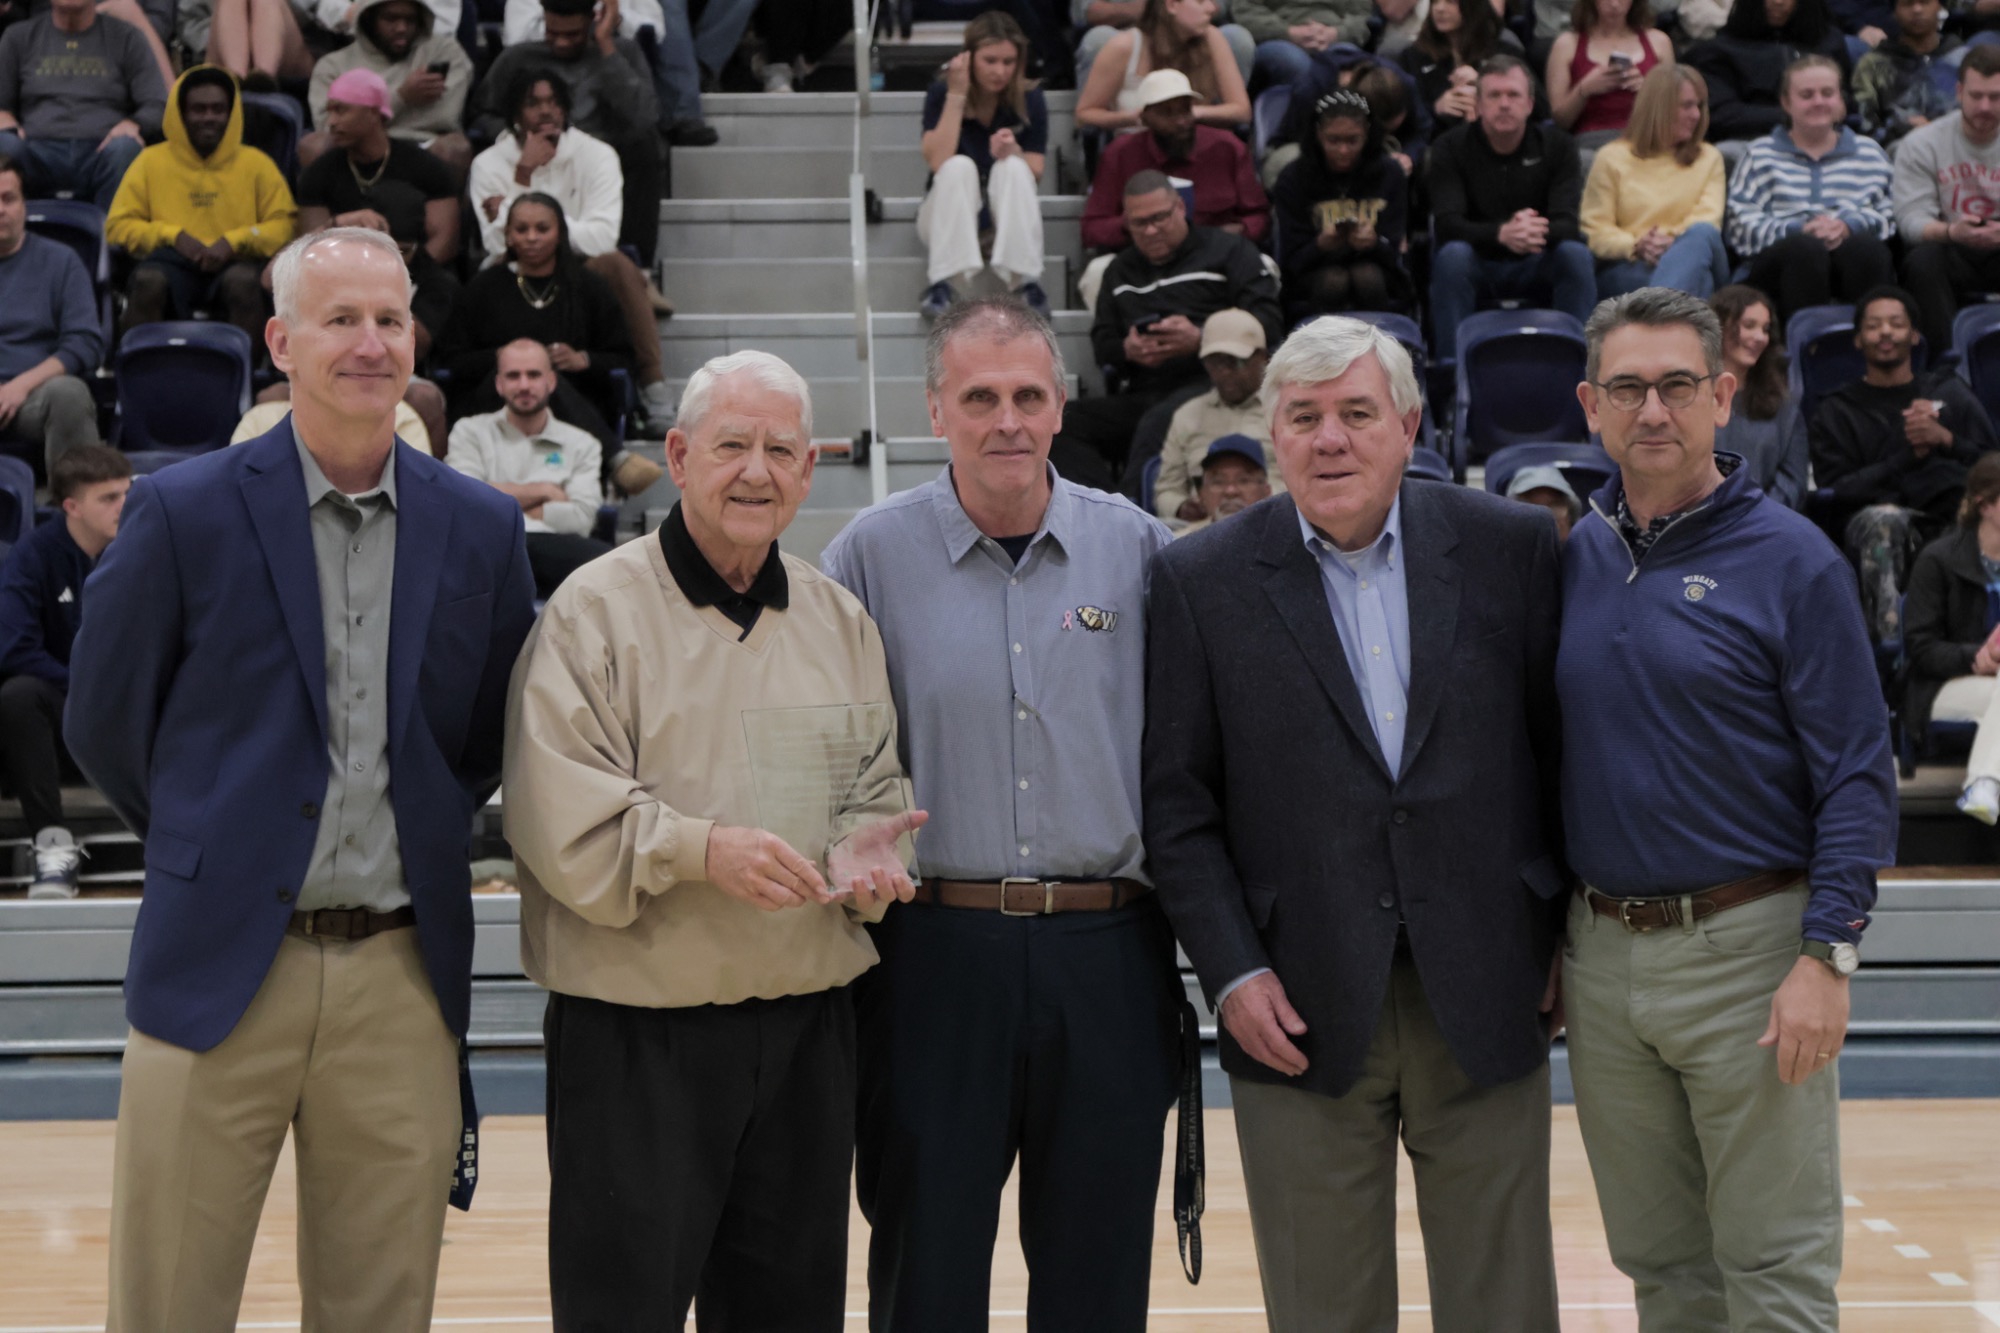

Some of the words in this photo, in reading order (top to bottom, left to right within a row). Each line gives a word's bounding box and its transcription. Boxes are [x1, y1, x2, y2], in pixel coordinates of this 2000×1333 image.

[1682, 574, 1719, 590] WINGATE
[1101, 611, 1118, 632] W
[1188, 1091, 1198, 1172] UNIVERSITY
